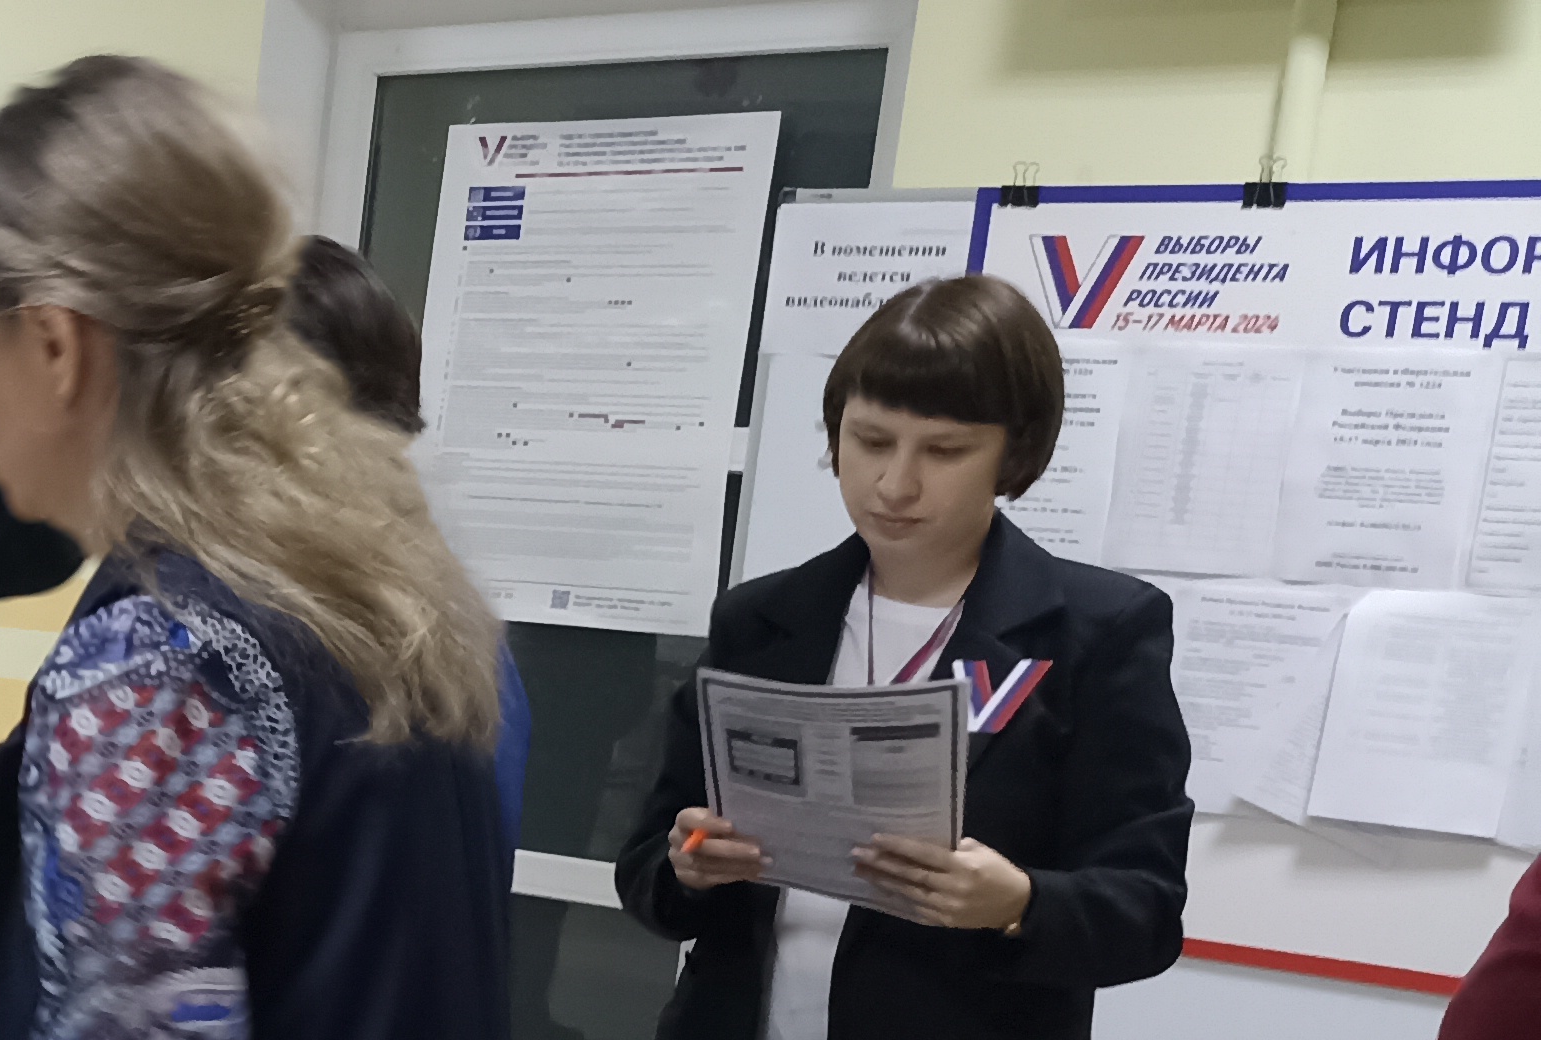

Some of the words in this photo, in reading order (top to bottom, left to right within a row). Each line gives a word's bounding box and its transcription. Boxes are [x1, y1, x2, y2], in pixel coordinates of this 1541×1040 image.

[1154, 235, 1263, 255] ВЫБОРЫ
[1138, 262, 1290, 285] ПРЕЗИДЕНТА
[1122, 289, 1220, 309] РОССИИ
[1163, 312, 1231, 333] МАРТА
[1231, 313, 1280, 334] 2024
[1339, 300, 1530, 350] СТЕНД
